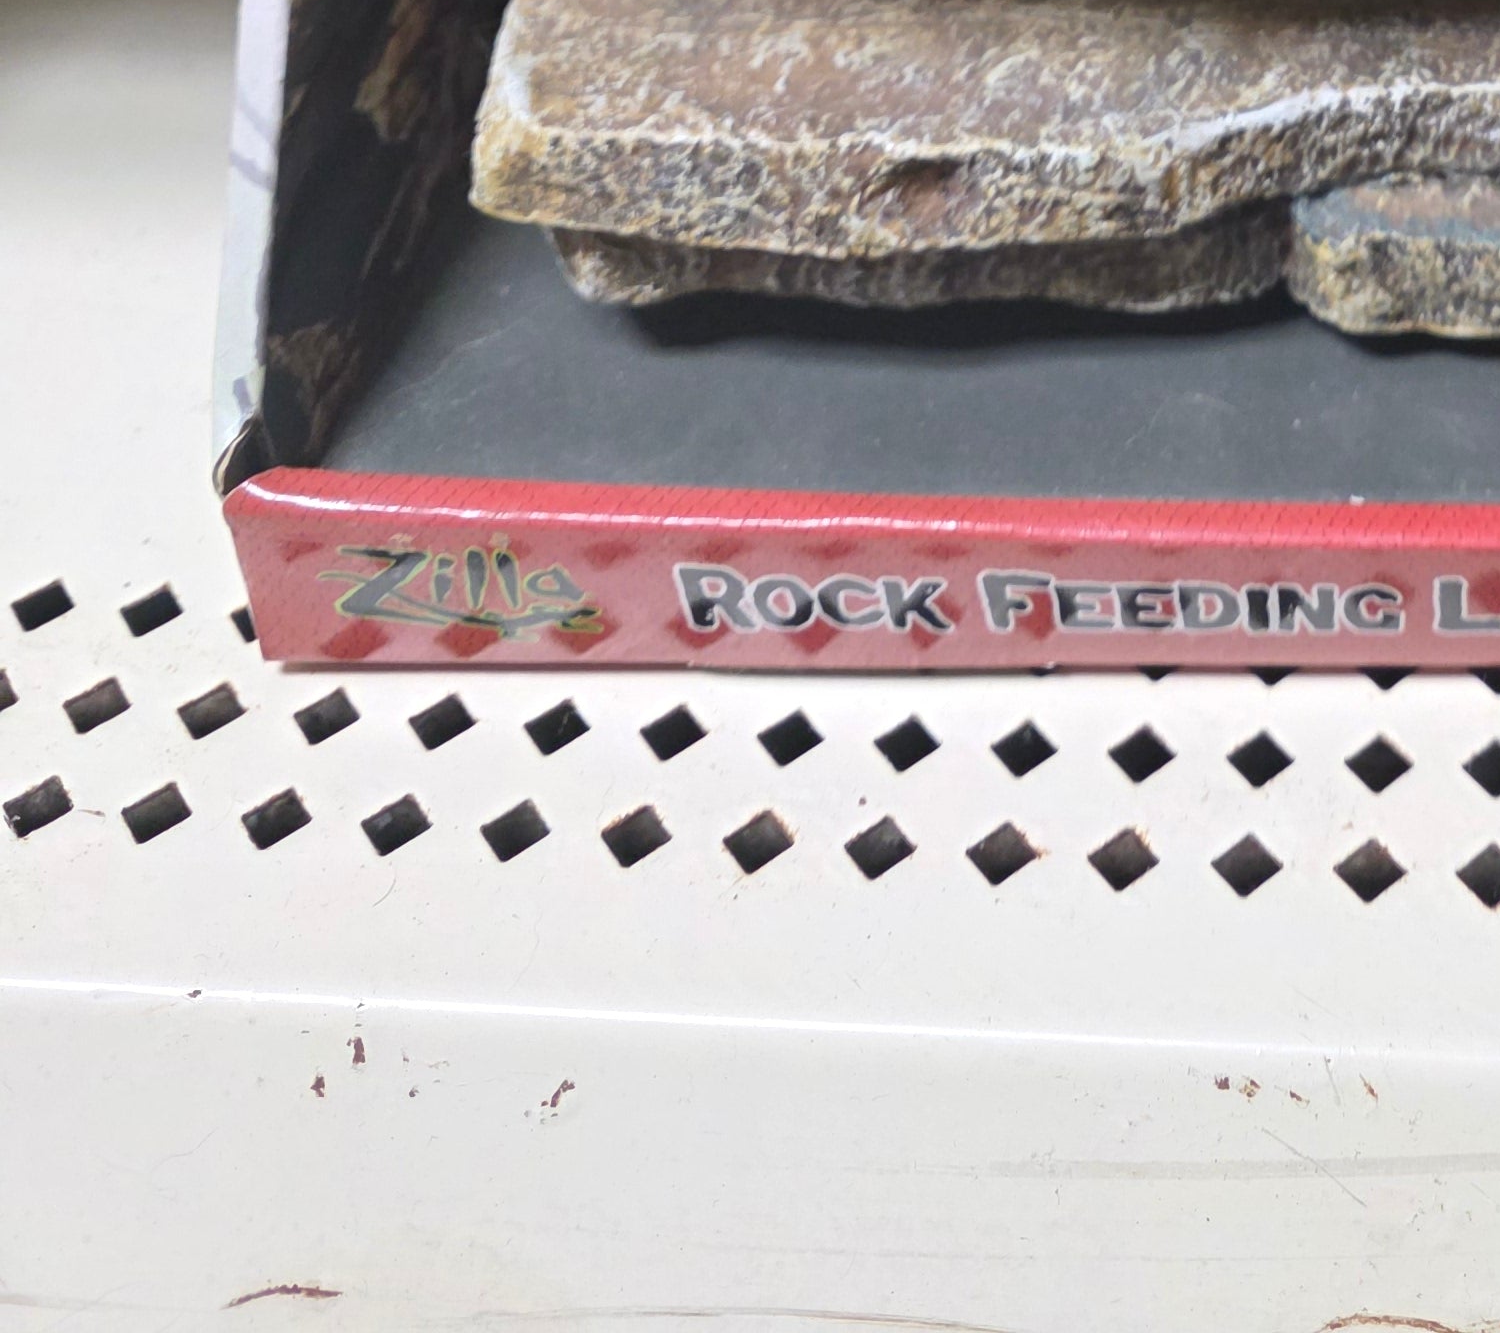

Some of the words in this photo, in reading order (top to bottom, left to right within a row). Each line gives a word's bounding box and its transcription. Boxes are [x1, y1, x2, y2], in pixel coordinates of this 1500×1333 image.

[320, 536, 600, 635] Zilla
[673, 563, 953, 634] ROCK
[979, 568, 1405, 637] FEEDING
